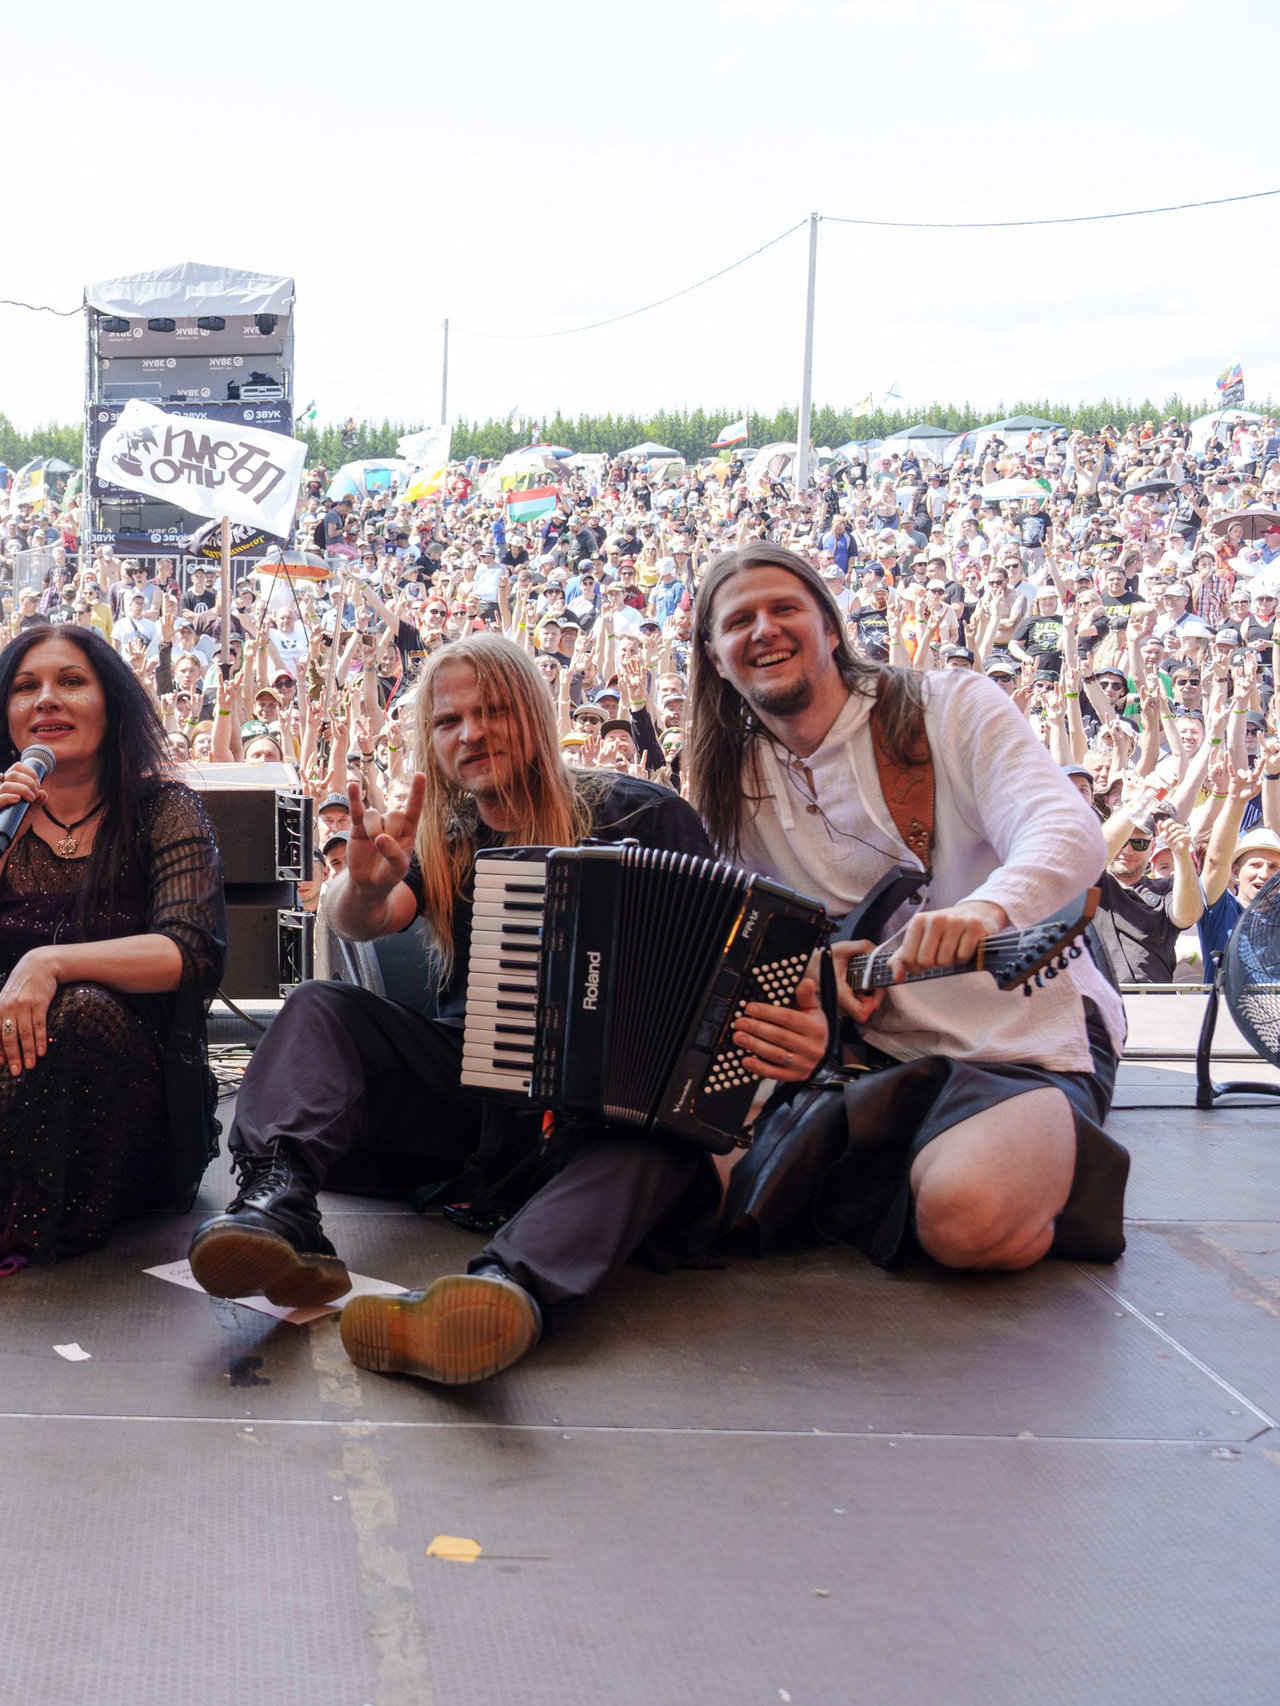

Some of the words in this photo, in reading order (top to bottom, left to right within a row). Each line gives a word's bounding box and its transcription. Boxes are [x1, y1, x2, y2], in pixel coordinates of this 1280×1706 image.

[255, 410, 281, 419] ЗВУК
[91, 534, 116, 542] ЗВУК
[582, 951, 602, 1010] Roland
